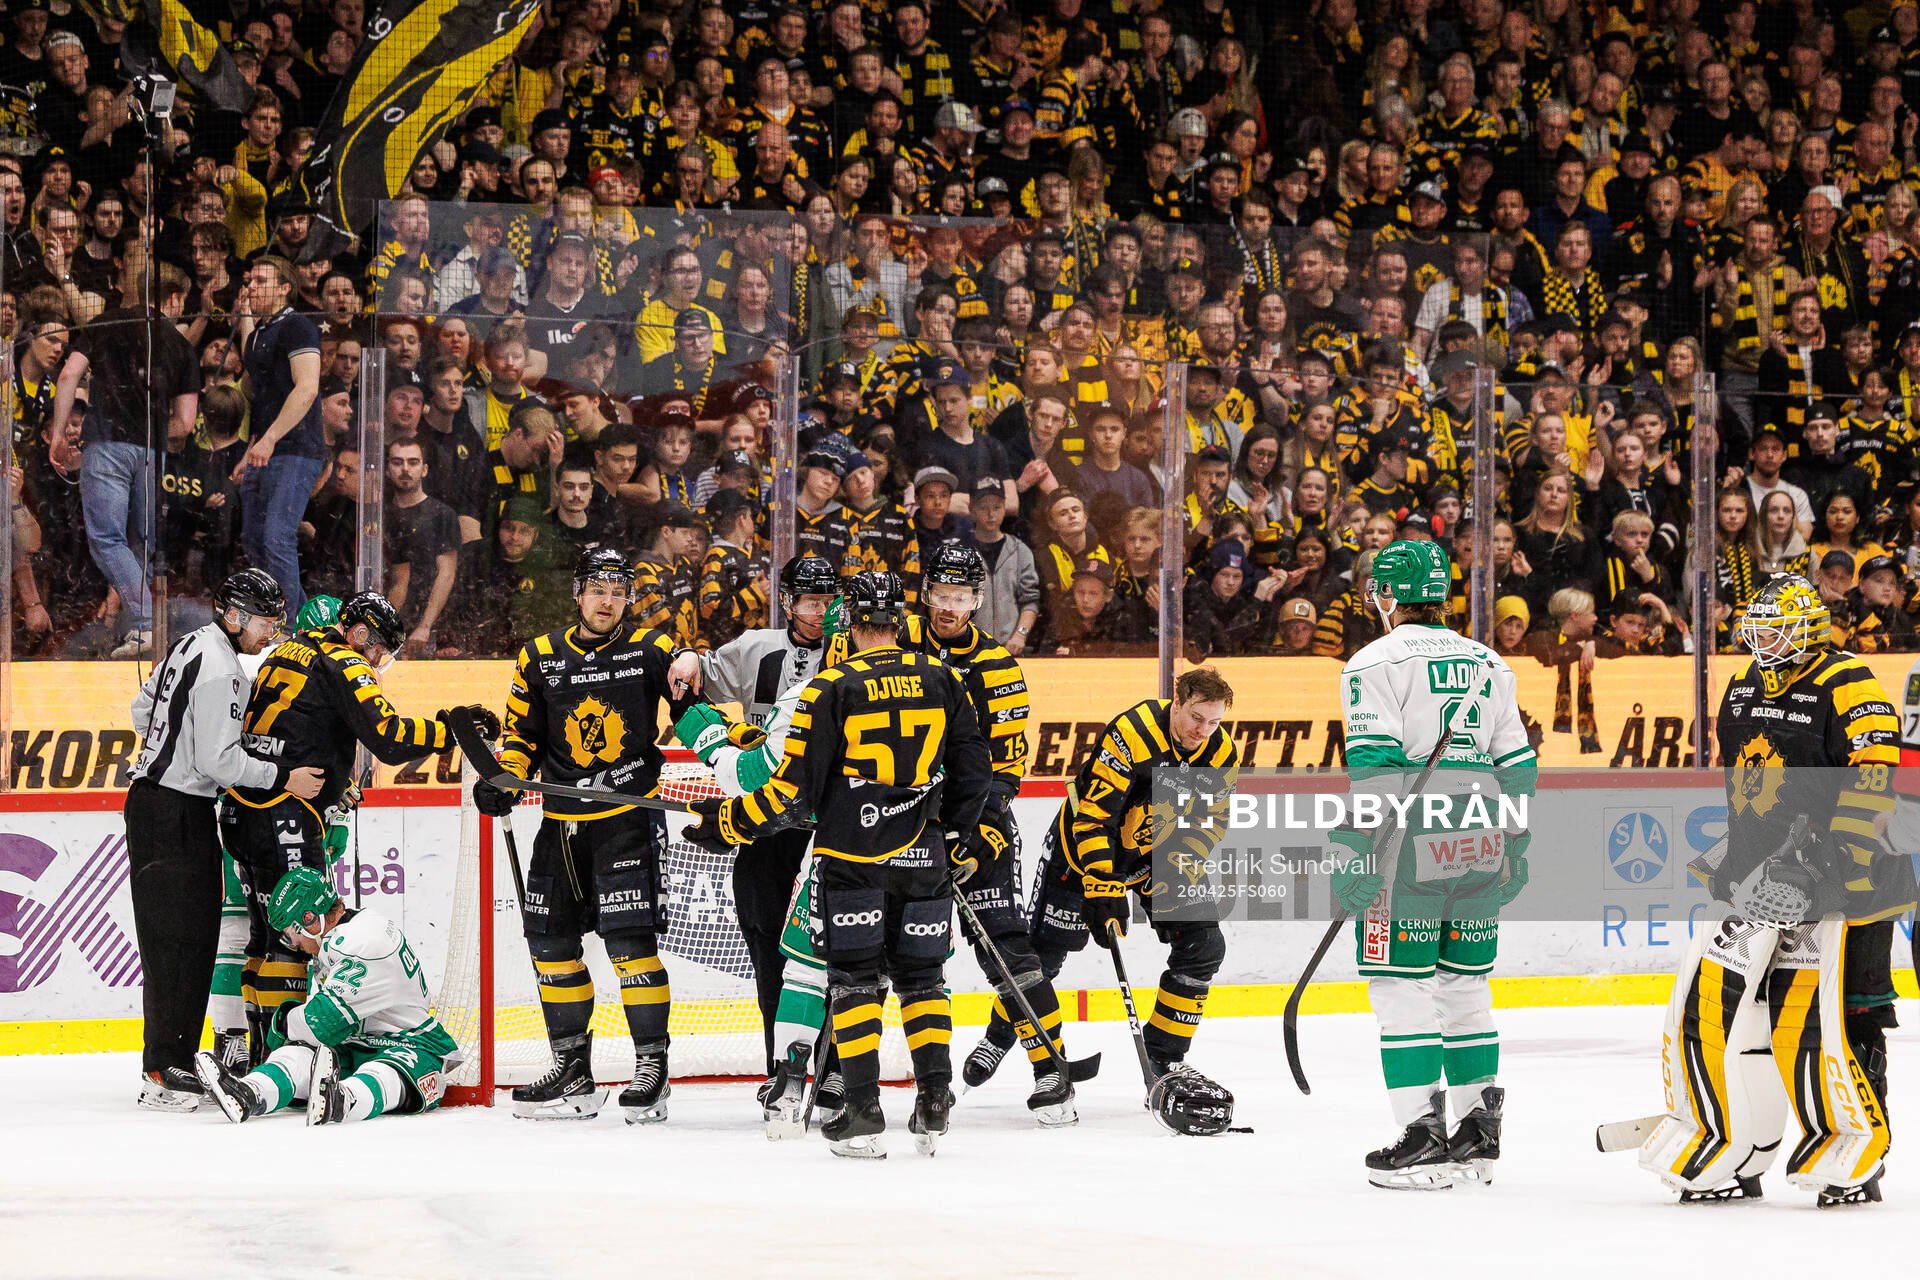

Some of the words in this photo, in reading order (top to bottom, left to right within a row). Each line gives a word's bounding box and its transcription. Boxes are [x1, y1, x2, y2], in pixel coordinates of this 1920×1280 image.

[613, 650, 643, 662] engcon
[570, 671, 610, 684] BOLIDEN
[615, 667, 644, 679] skebo
[864, 676, 923, 701] DJUSE
[994, 683, 1025, 697] HOLMEN
[1791, 692, 1818, 703] engcon
[997, 707, 1014, 724] SK
[1751, 707, 1785, 720] BOLIDEN
[1787, 711, 1812, 725] skebo
[1849, 704, 1891, 720] HOLMEN
[843, 708, 946, 787] 57
[1005, 734, 1025, 760] 15
[1852, 731, 1873, 751] SK
[10, 730, 147, 788] KOR
[610, 757, 645, 779] Skellefteå
[613, 772, 634, 787] Kraft
[1854, 763, 1889, 792] 38
[1085, 778, 1115, 802] 17
[613, 859, 641, 869] CCM
[890, 859, 933, 868] PRODUKTER
[275, 880, 292, 906] CATENA
[599, 889, 642, 904] BASTU
[1085, 884, 1125, 894] CCM
[600, 901, 650, 913] PRODUKTER
[1045, 903, 1081, 922] BAST
[833, 909, 883, 927] coop
[1380, 909, 1390, 943] BYGG
[904, 920, 949, 937] coop
[1732, 959, 1747, 971] Kraft
[1805, 955, 1820, 965] Kraft
[333, 959, 368, 988] 22
[1120, 981, 1141, 1035] CCM
[563, 1074, 586, 1092] CCM
[1826, 1054, 1864, 1131] CCM
[1849, 1059, 1883, 1128] CCM
